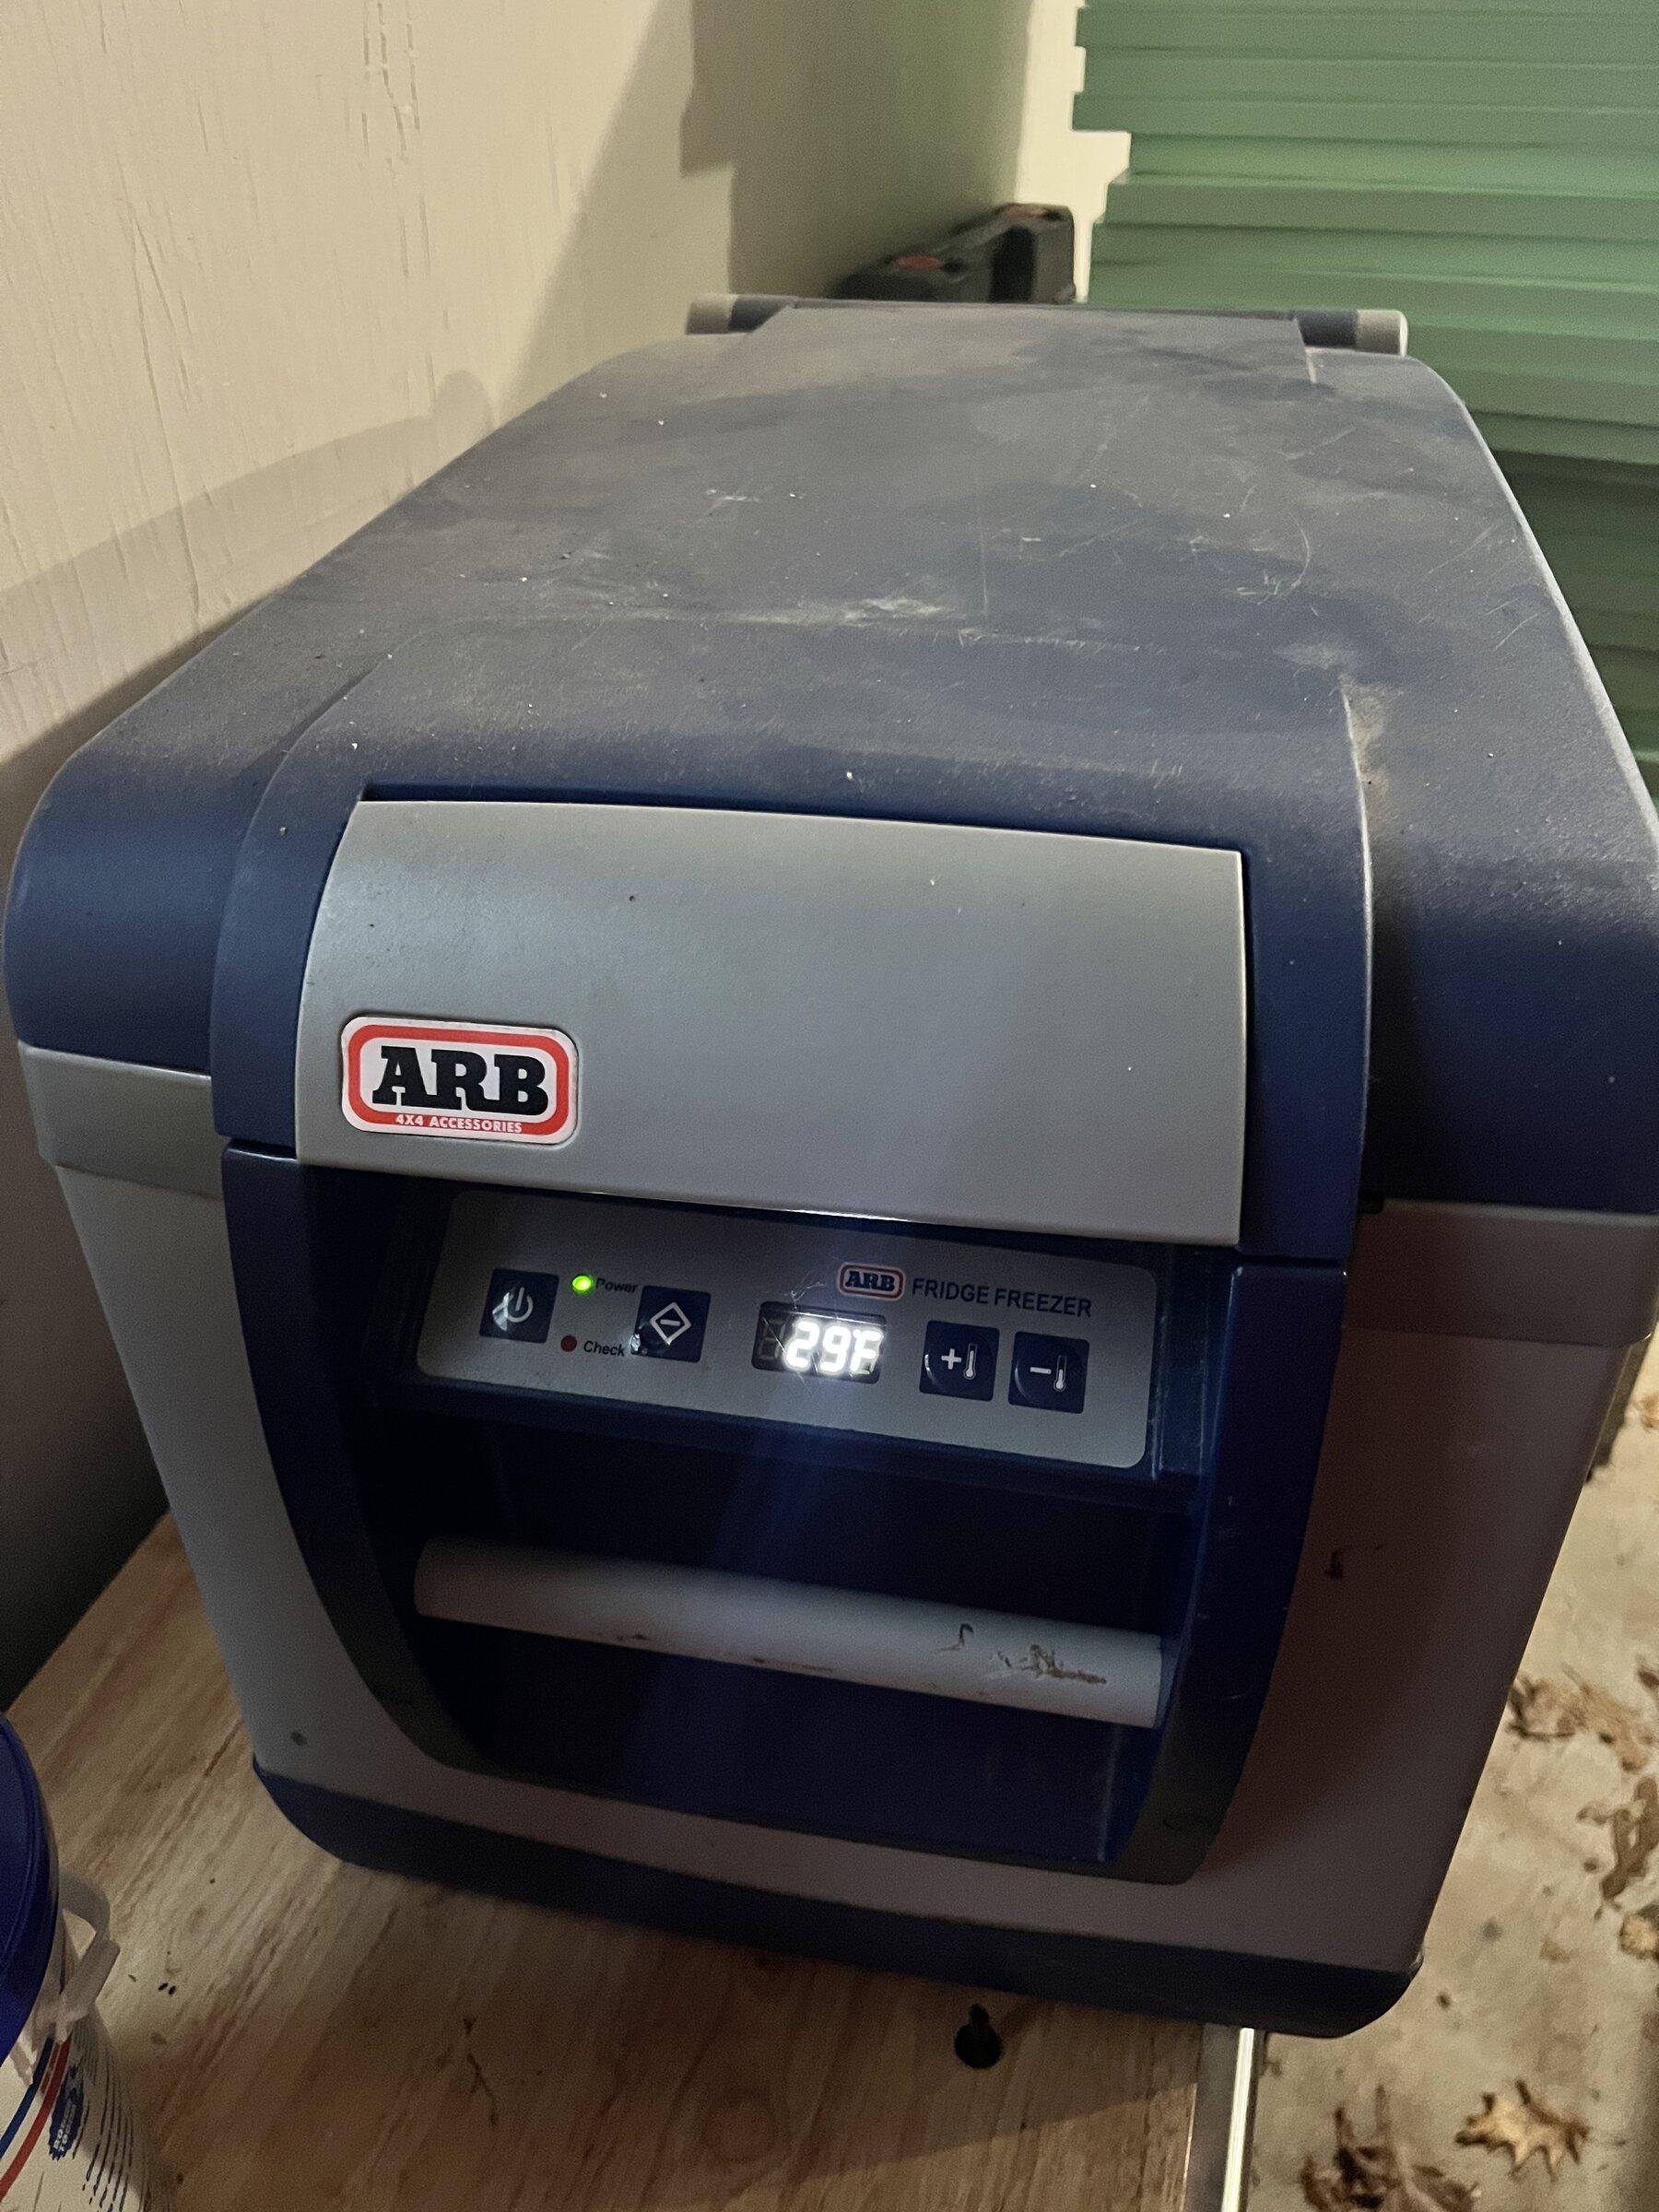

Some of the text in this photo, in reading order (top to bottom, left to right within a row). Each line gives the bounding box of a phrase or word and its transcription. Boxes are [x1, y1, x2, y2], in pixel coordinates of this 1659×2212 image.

[372, 1045, 549, 1116] ARB
[394, 1112, 523, 1134] 4X4 ACCESSORIES
[595, 1277, 639, 1293] Power
[844, 1271, 896, 1291] ARB
[912, 1277, 1092, 1318] FRIDGE FREEZER
[583, 1340, 625, 1357] Check
